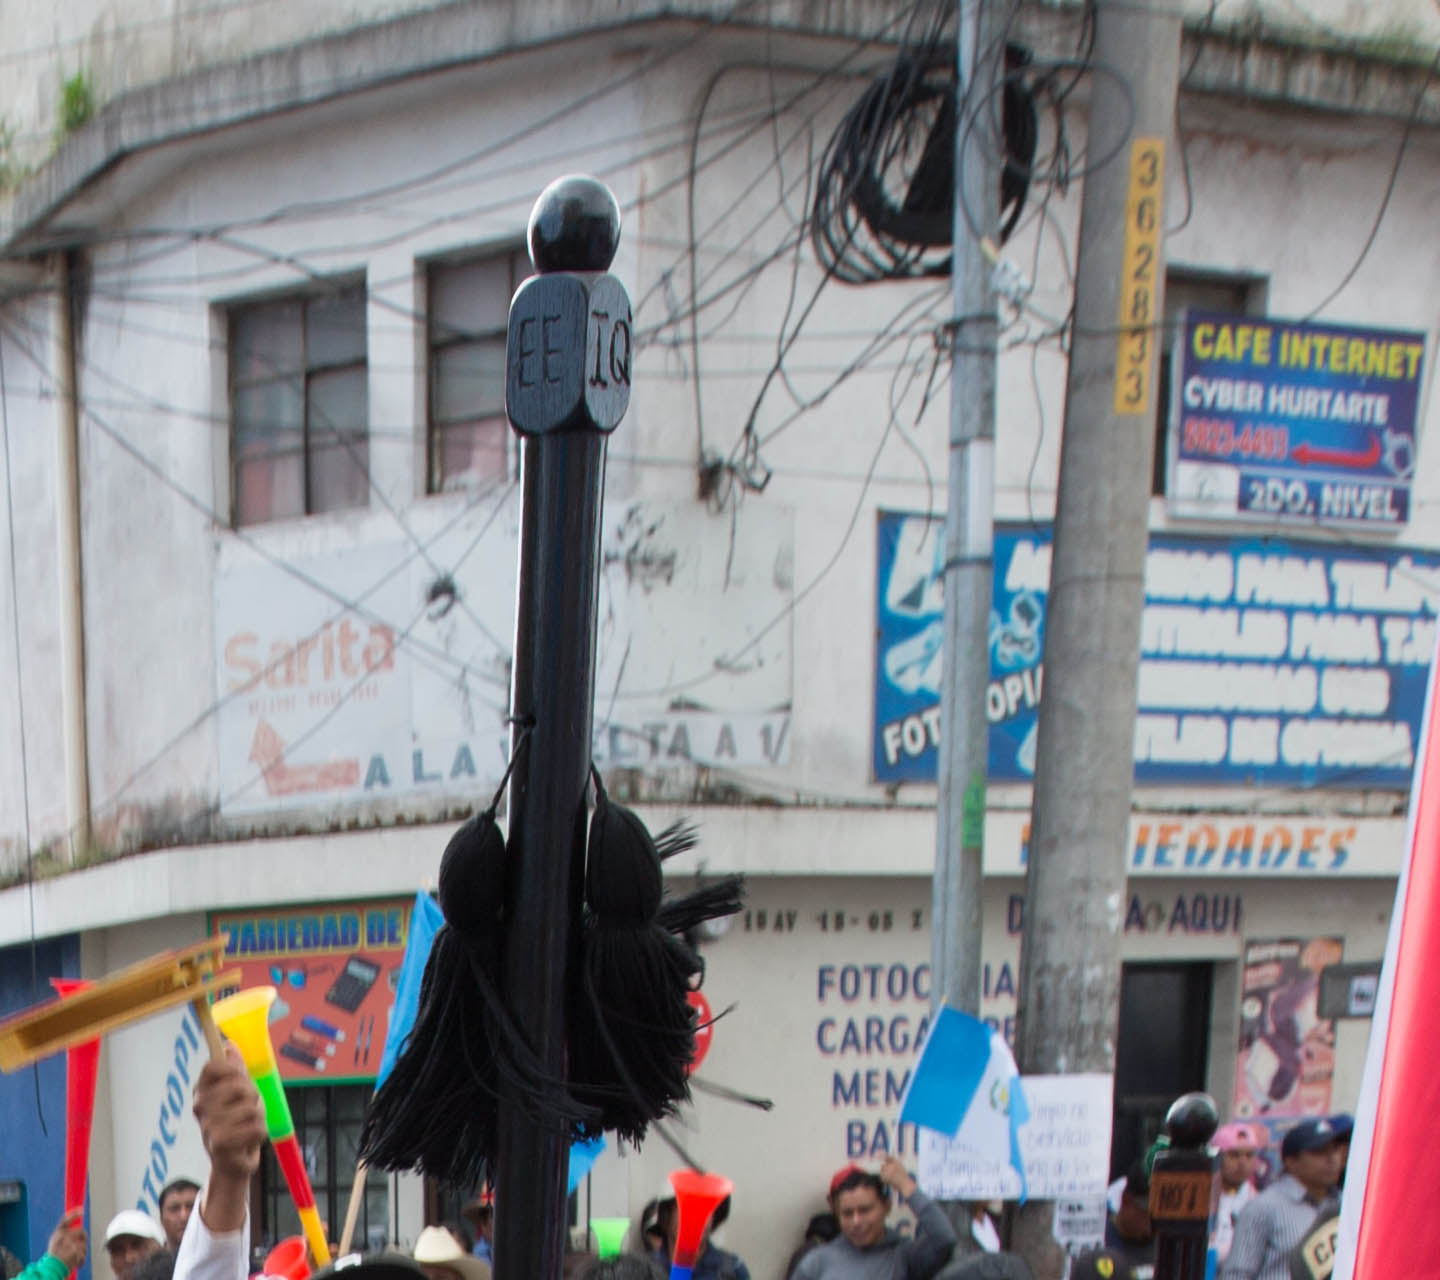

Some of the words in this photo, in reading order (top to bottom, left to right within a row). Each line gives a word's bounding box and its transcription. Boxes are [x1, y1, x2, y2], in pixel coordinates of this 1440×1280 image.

[1193, 322, 1272, 366] CAFE
[1279, 330, 1424, 381] INTERNET
[1184, 374, 1264, 412] CYBER
[1268, 382, 1391, 426] HURTARTE
[1248, 478, 1315, 515] 2DO.
[1321, 483, 1400, 522] NIVEL
[224, 616, 396, 694] Sarita
[364, 753, 390, 790] A
[365, 903, 404, 947] DE
[1169, 895, 1243, 932] AQUI
